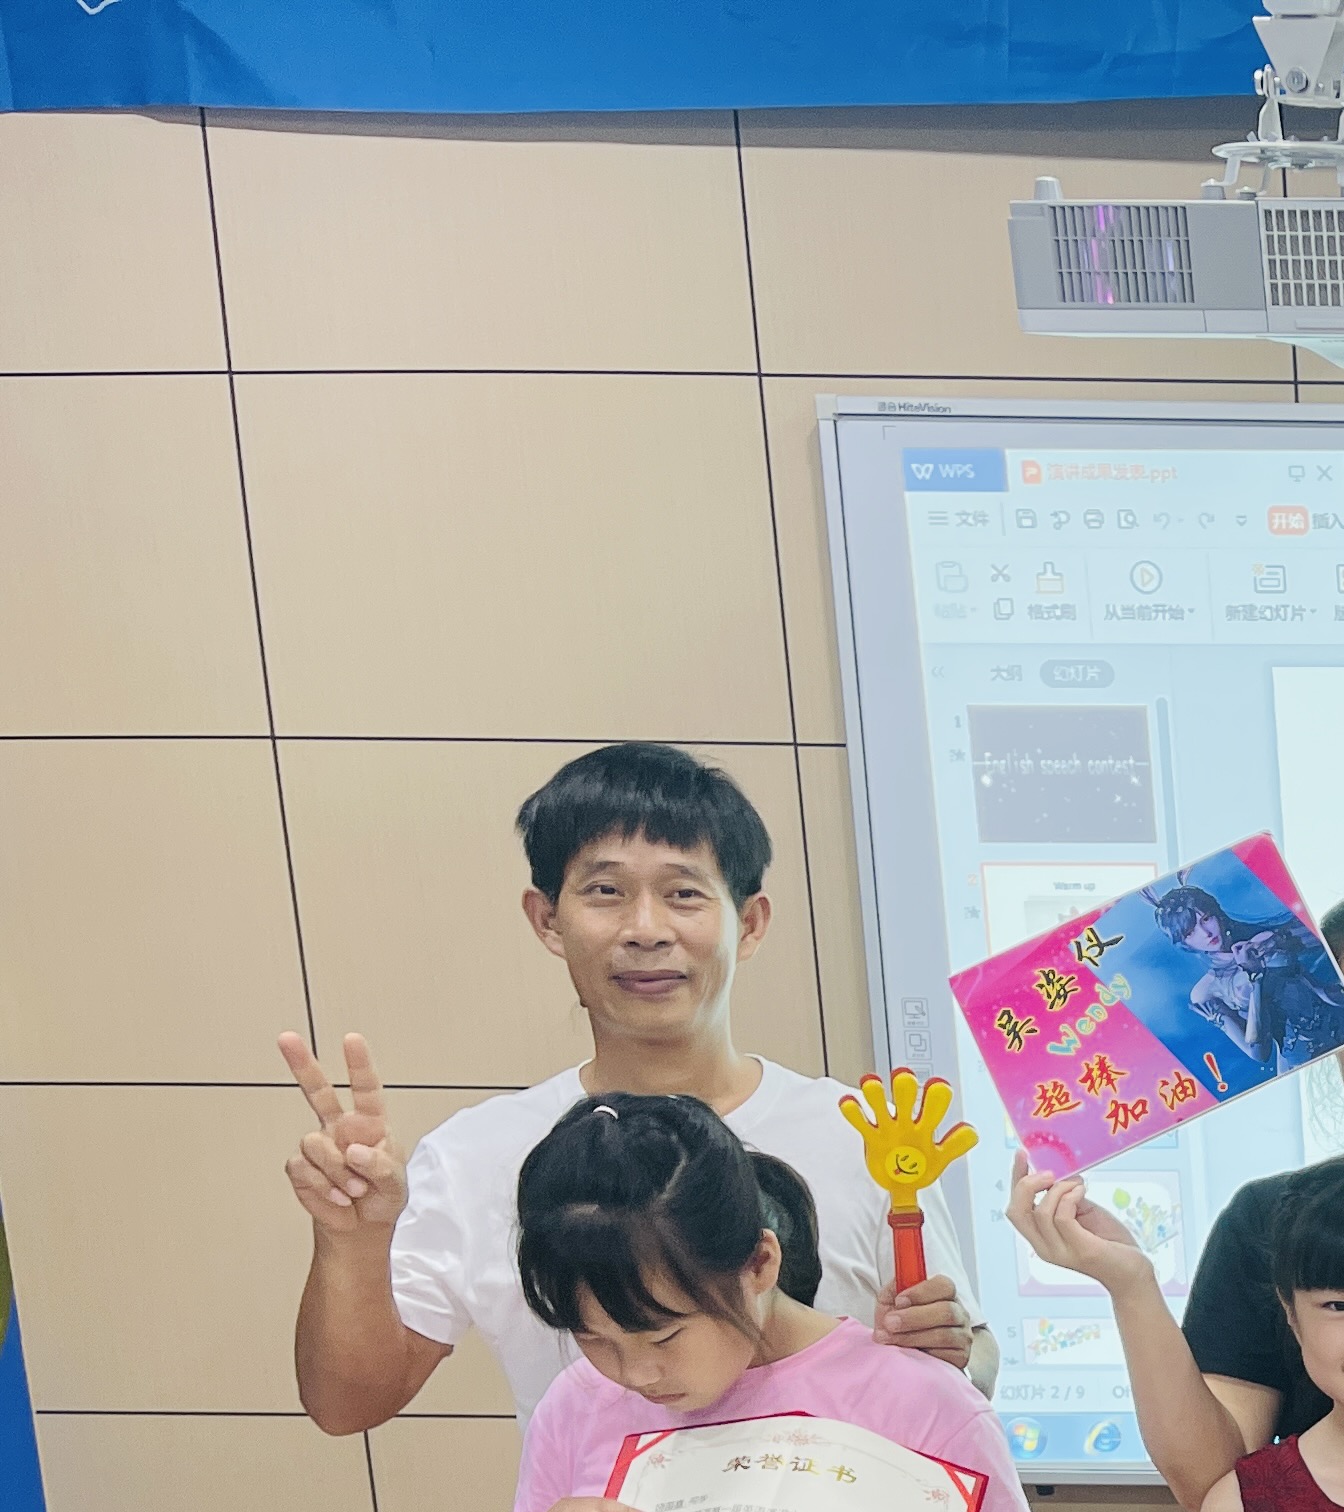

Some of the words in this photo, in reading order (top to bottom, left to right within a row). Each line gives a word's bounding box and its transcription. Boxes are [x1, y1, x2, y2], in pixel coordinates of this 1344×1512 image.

[938, 464, 975, 478] WPS
[955, 511, 989, 527] 文件
[1271, 513, 1305, 531] 开始
[1027, 604, 1077, 621] 格式刷
[1104, 603, 1185, 621] 从当前开始
[1226, 604, 1306, 621] 新建幻灯片
[990, 665, 1023, 681] 大纲
[1053, 665, 1101, 681] 幻灯片
[985, 752, 1034, 774] English
[1088, 756, 1135, 774] contest
[1053, 882, 1081, 890] Warm
[1084, 882, 1096, 892] up
[1047, 973, 1132, 1056] Wendy
[1033, 1054, 1129, 1118] 超棒
[1106, 1052, 1229, 1135] 加油!
[1000, 1385, 1045, 1400] 幻灯片
[1051, 1386, 1060, 1399] 2
[1075, 1385, 1085, 1398] 9
[721, 1453, 858, 1484] 荣誉证书
